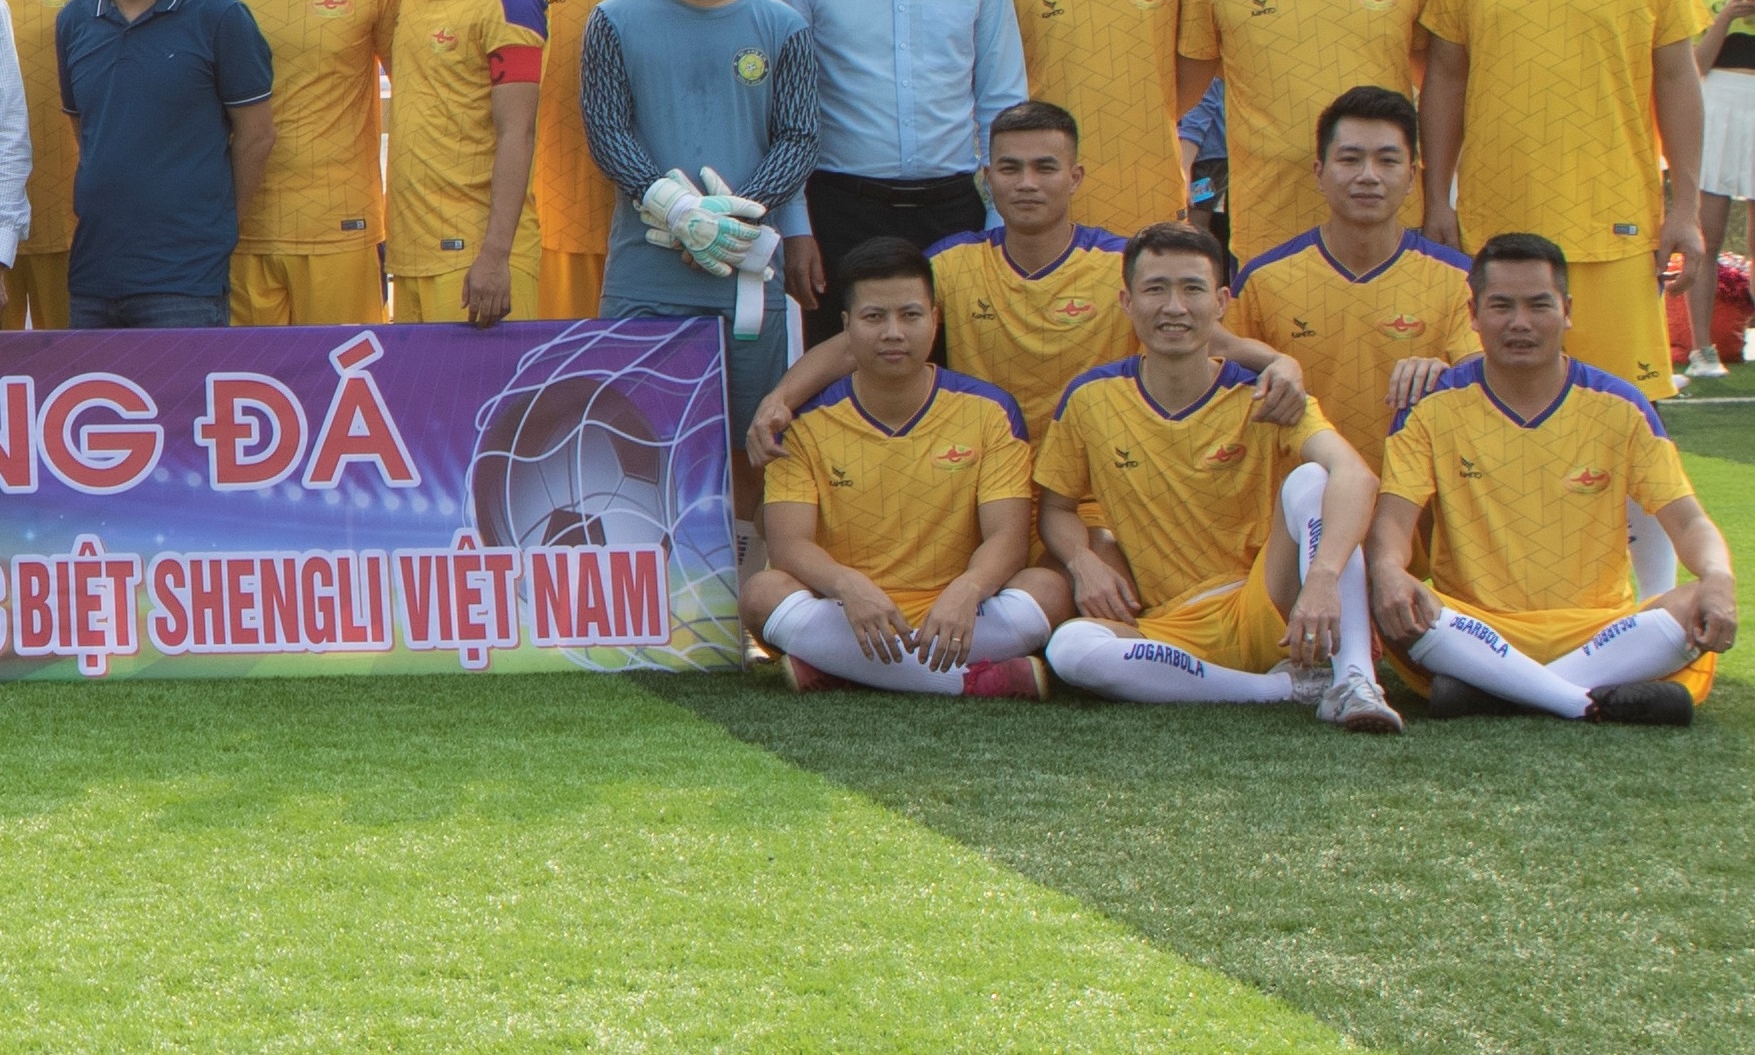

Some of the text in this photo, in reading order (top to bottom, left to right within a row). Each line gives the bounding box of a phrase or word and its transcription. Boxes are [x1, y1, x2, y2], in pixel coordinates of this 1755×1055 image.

[195, 331, 419, 490] ĐÁ
[16, 537, 139, 675] BIỆT
[151, 552, 392, 651] SHENGLI
[397, 531, 521, 669] VIỆT
[529, 548, 669, 645] NAM
[1449, 616, 1509, 658] JGARBOLA
[1123, 642, 1205, 678] JOGARBOLA
